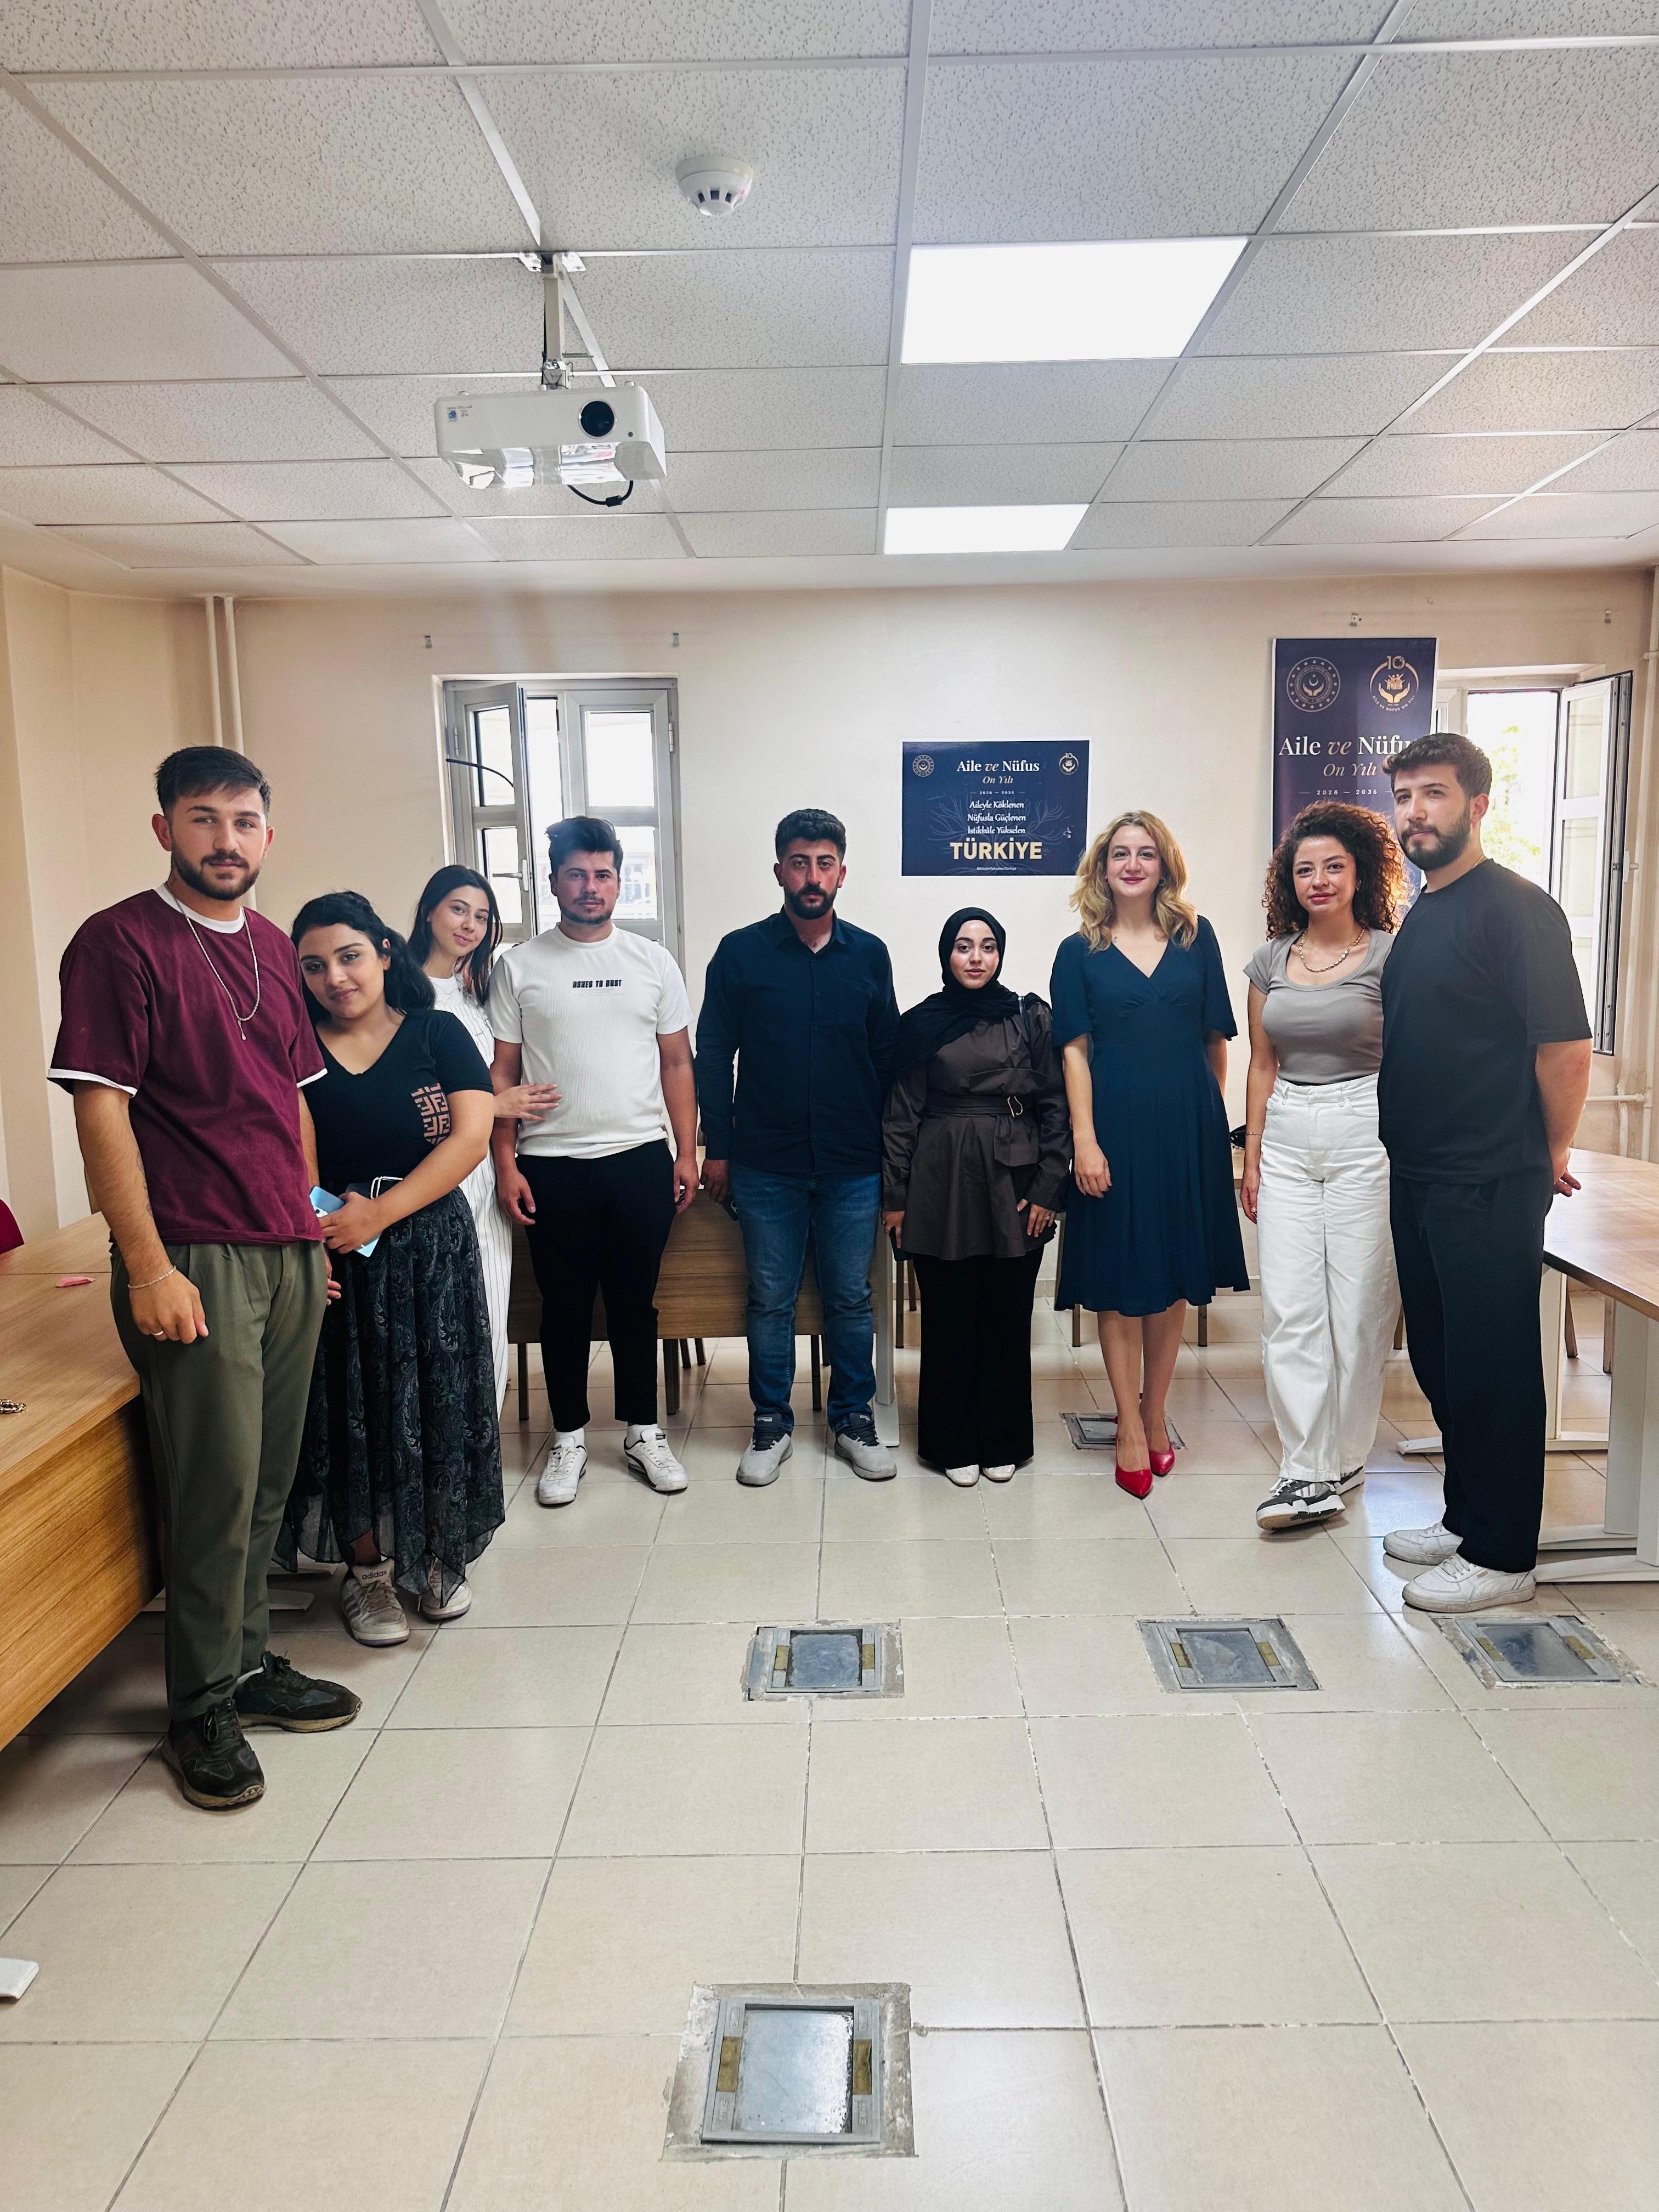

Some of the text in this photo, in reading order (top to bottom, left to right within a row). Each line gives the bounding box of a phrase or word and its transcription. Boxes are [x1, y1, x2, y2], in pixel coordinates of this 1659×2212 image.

[1278, 735, 1411, 755] Aile ve Nüfu
[956, 760, 1040, 772] Aile ve Nüfus
[1323, 763, 1377, 777] On Yılı
[982, 775, 1014, 784] On Yılı
[969, 799, 1025, 811] Aileyle Köklenen
[967, 812, 1026, 824] Nüfusla Güçlenen
[996, 825, 1026, 834] Yükselen
[950, 837, 1042, 860] TÜRKİYE
[362, 1570, 387, 1579] adidas
